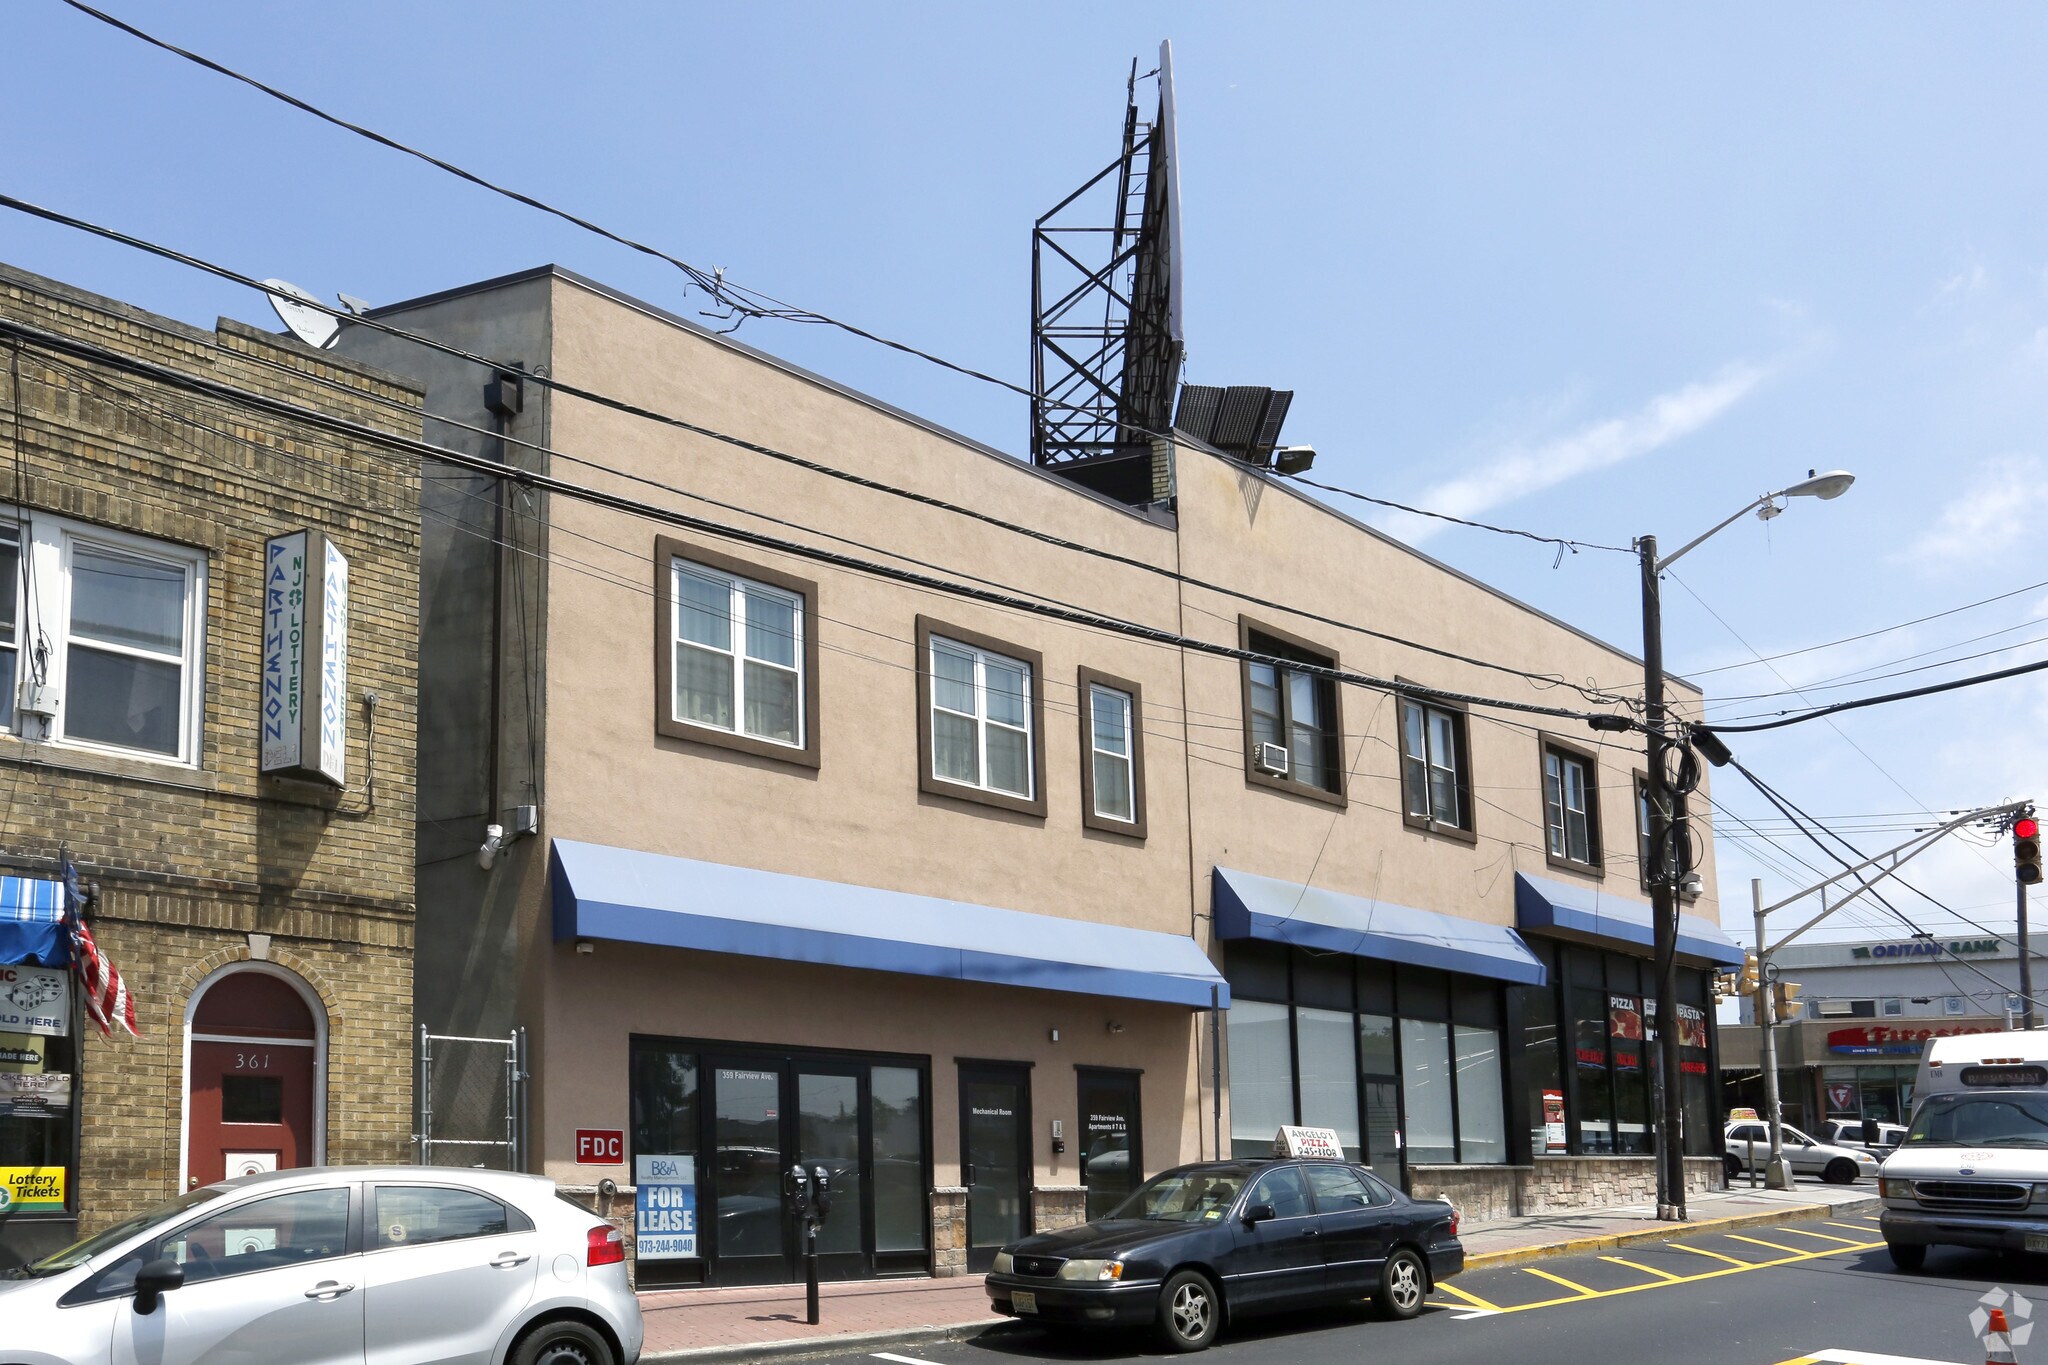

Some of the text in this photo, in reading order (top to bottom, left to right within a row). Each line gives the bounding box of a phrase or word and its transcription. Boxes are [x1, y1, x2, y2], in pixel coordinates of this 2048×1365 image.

[264, 543, 287, 743] PARTHENON
[322, 544, 338, 750] PARTHENON
[288, 613, 301, 724] LOTTERY
[1872, 939, 2000, 958] ORITANI BANK
[1610, 996, 1635, 1011] PIZZA
[0, 1014, 61, 1028] LD HERE
[1678, 1008, 1701, 1021] PASTA
[19, 1053, 39, 1062] HERE
[235, 1053, 269, 1069] 361
[722, 1071, 774, 1081] 359 Fairview Ave.
[972, 1107, 1012, 1116] Mechanical Room
[1292, 1130, 1333, 1140] ANGELO'S
[580, 1137, 619, 1156] FDC
[1301, 1138, 1329, 1148] PIZZA
[1297, 1146, 1338, 1157] 945-3308
[651, 1160, 679, 1176] B&A
[9, 1173, 57, 1187] Lottery
[16, 1185, 60, 1197] Tickets
[647, 1186, 684, 1208] FOR
[639, 1209, 693, 1232] LEASE
[638, 1238, 693, 1254] 973-244-9040
